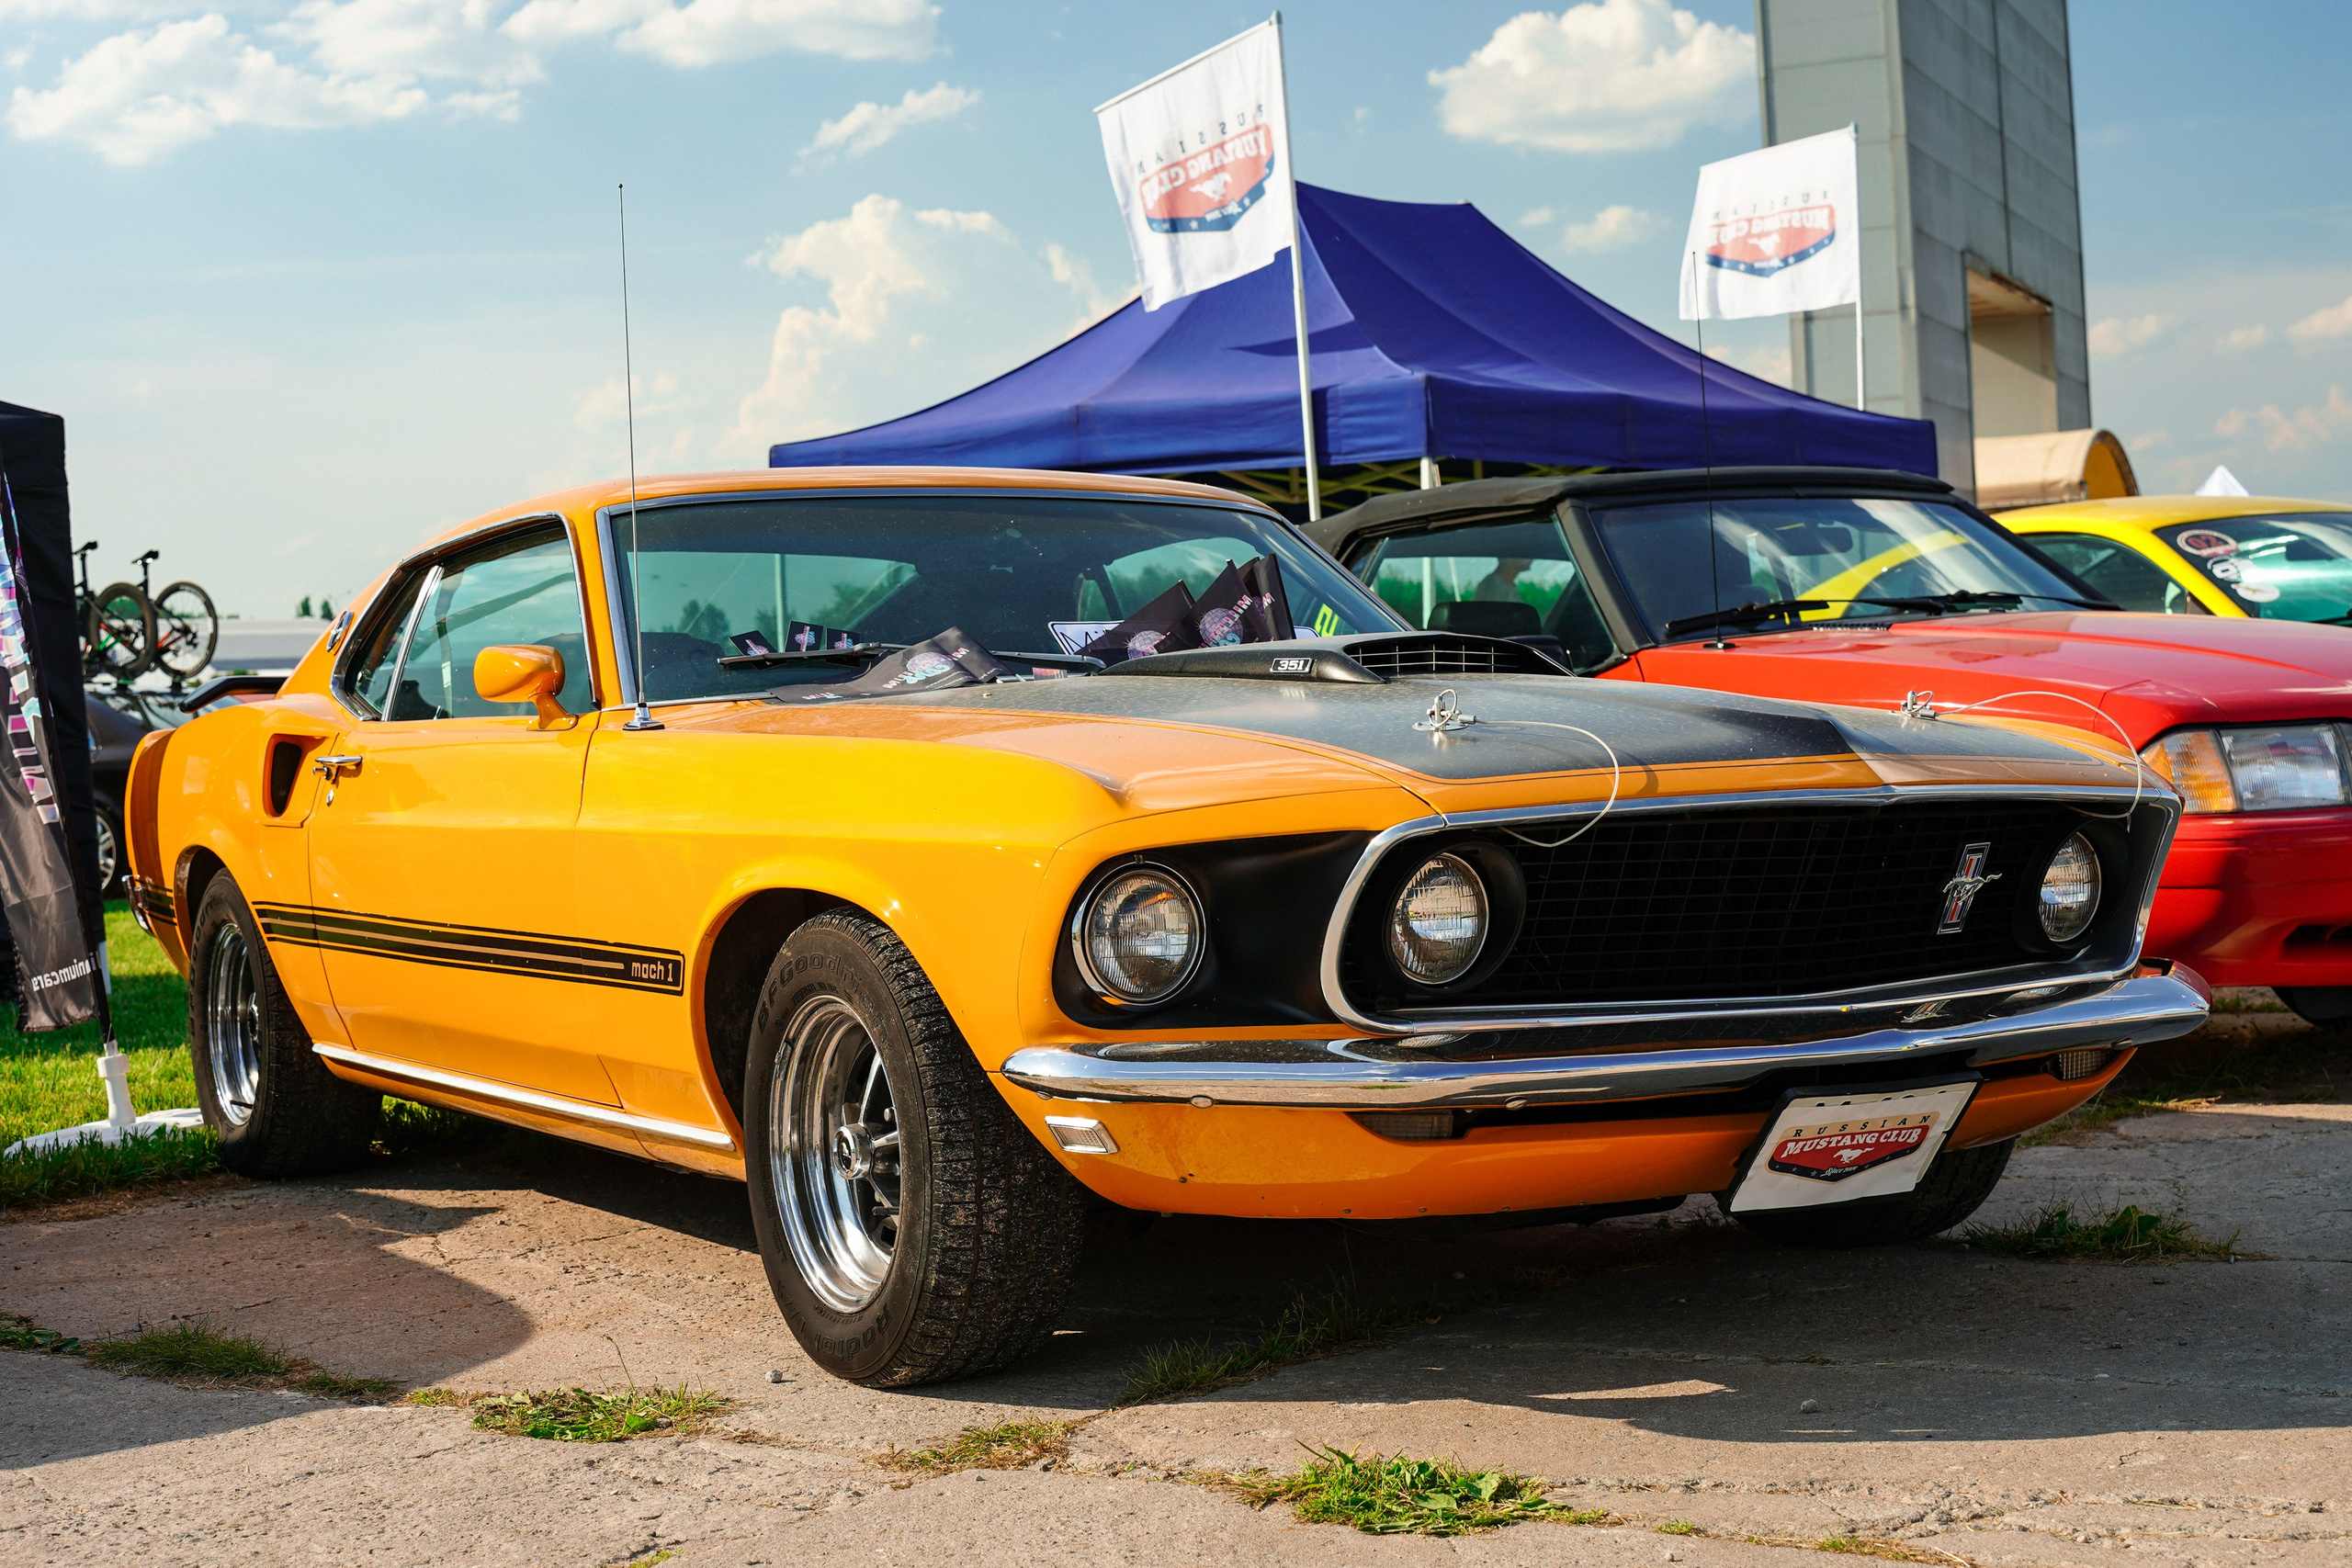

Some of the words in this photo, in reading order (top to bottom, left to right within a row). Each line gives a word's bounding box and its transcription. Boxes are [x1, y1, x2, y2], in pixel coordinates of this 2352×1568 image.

[1277, 660, 1305, 671] 351
[631, 961, 664, 980] mach
[667, 963, 673, 982] 1
[1792, 1114, 1931, 1138] RUSSIAN
[1781, 1133, 1879, 1159] MUSTANG
[1879, 1128, 1923, 1144] CLUB
